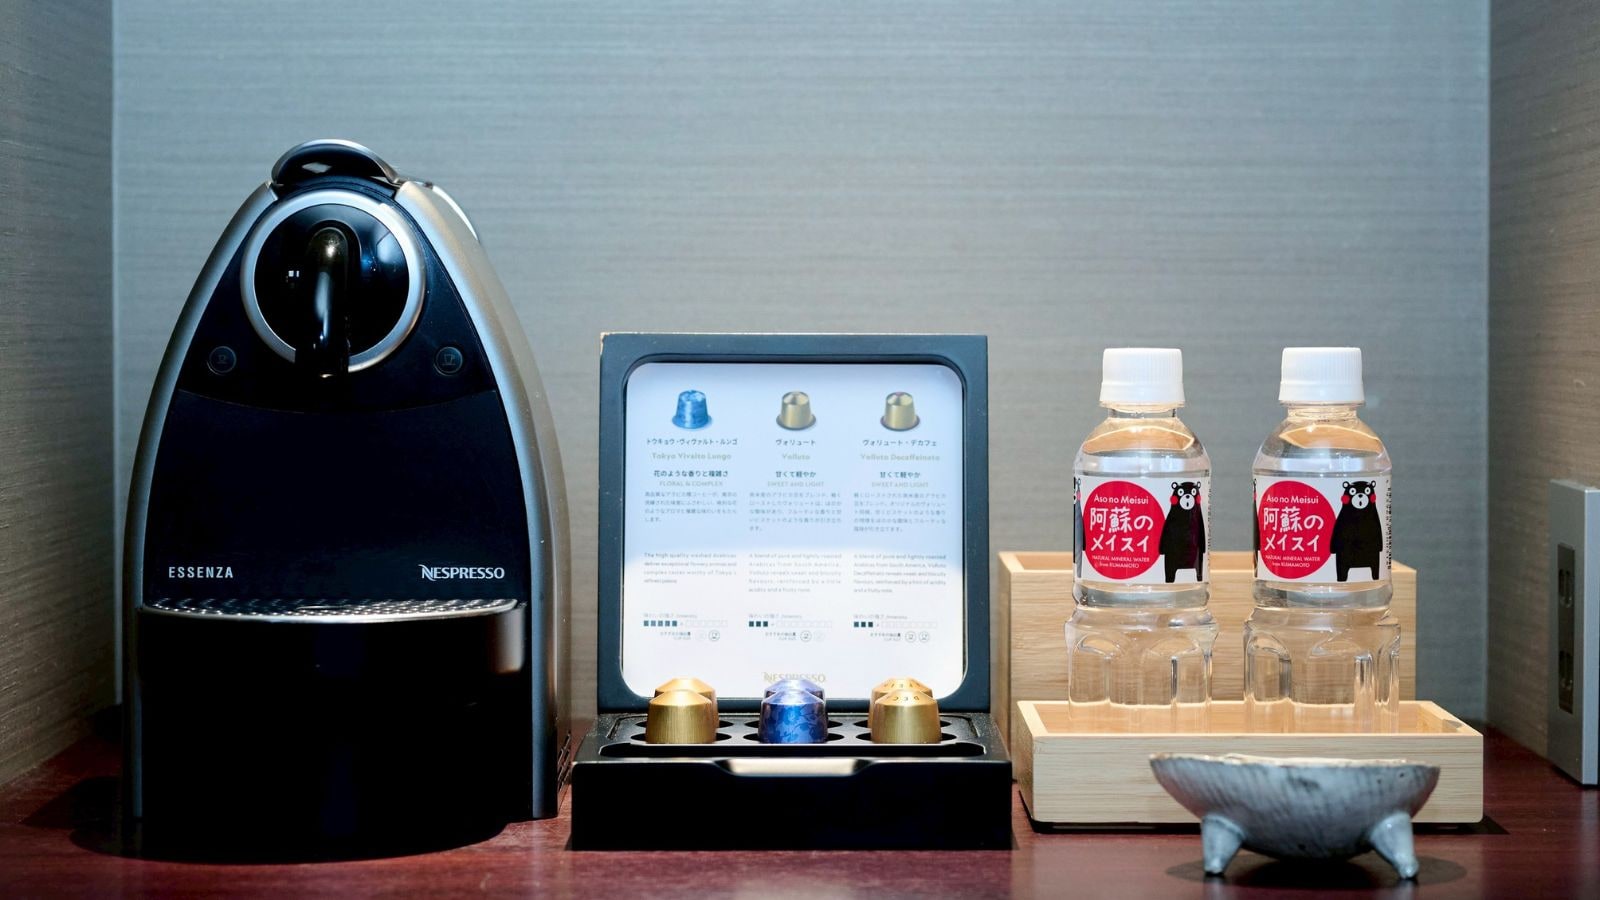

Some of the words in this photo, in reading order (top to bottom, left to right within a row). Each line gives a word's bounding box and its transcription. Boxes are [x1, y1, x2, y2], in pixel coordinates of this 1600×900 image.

[653, 453, 676, 461] Tokyo
[708, 453, 731, 461] Lungo
[1094, 494, 1107, 503] Aso
[1121, 495, 1149, 504] Meisui
[1267, 494, 1278, 503] Aso
[1291, 495, 1319, 504] Meisui
[1090, 506, 1153, 533] 阿蘇の
[1263, 506, 1324, 533] 阿蘇の
[1091, 534, 1150, 553] メイスイ
[1264, 534, 1320, 552] メイスイ
[169, 566, 234, 578] ESSENZA
[418, 564, 505, 581] NESPRESSO
